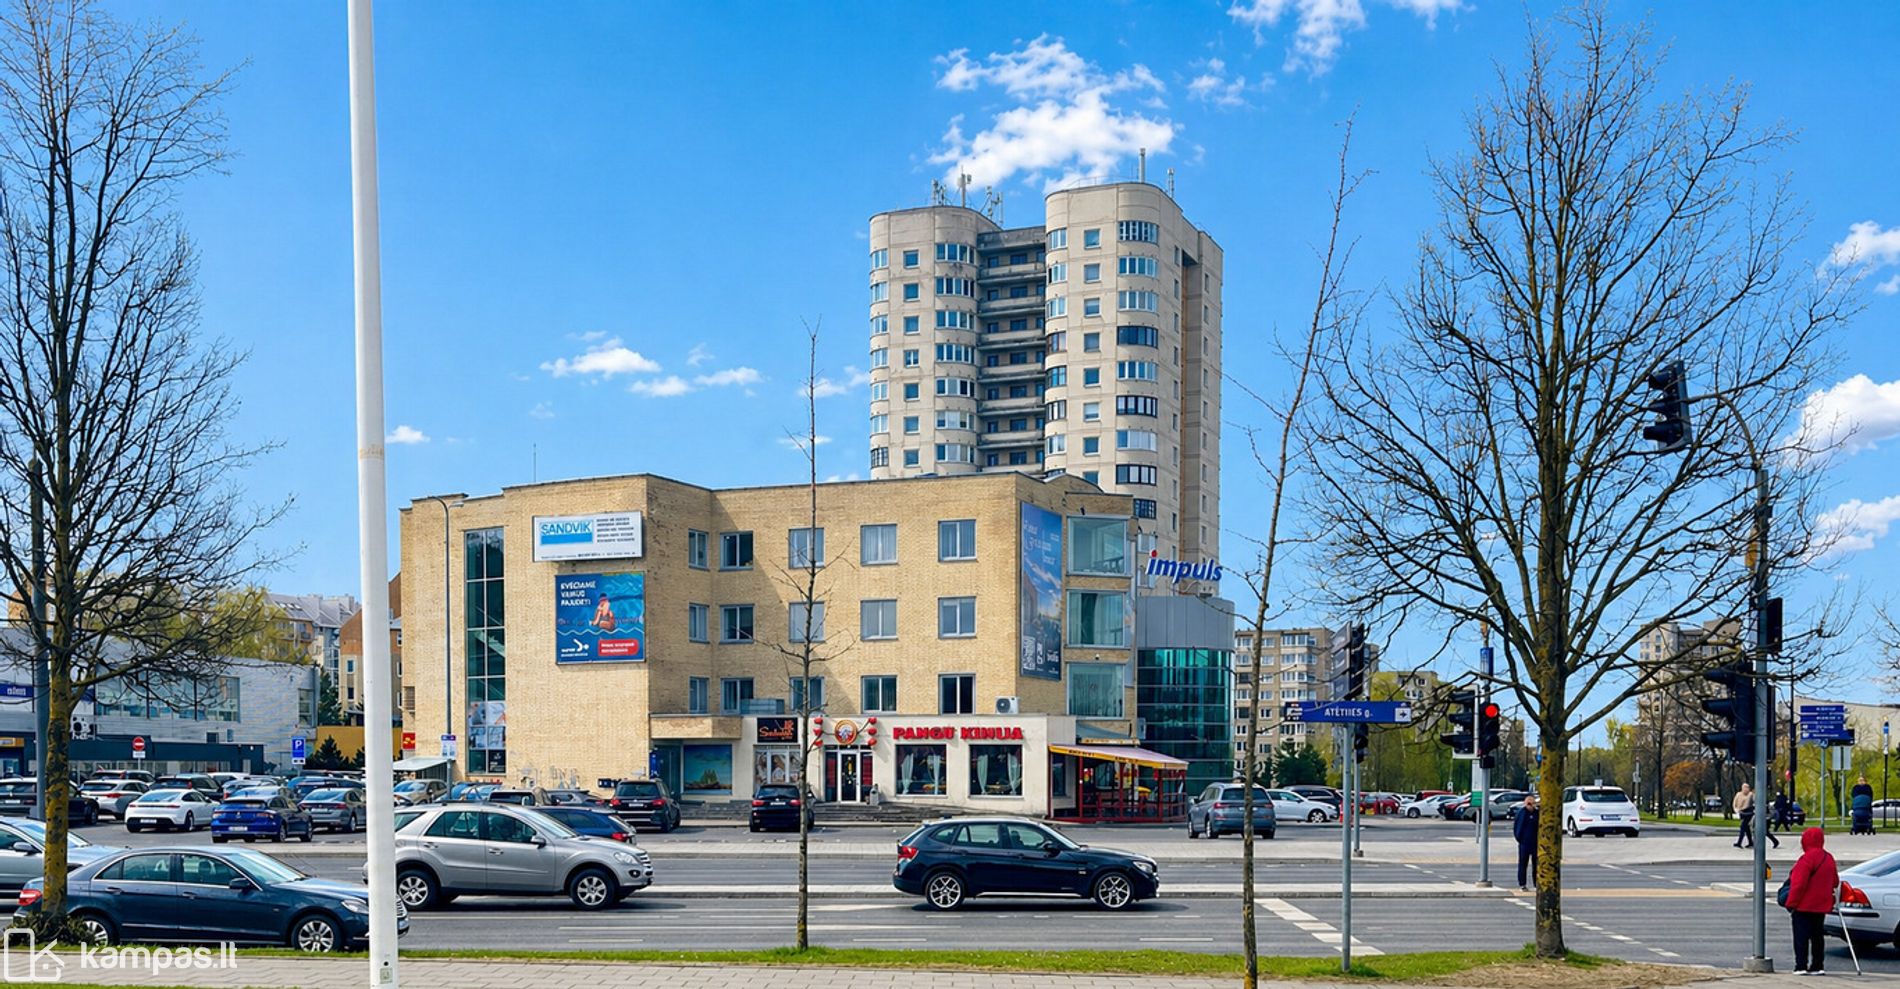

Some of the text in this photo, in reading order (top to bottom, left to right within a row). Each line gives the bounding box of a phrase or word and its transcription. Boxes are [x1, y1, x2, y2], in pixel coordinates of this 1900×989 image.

[541, 522, 591, 534] SANDVIK
[1146, 550, 1222, 584] impuls
[295, 740, 302, 749] P
